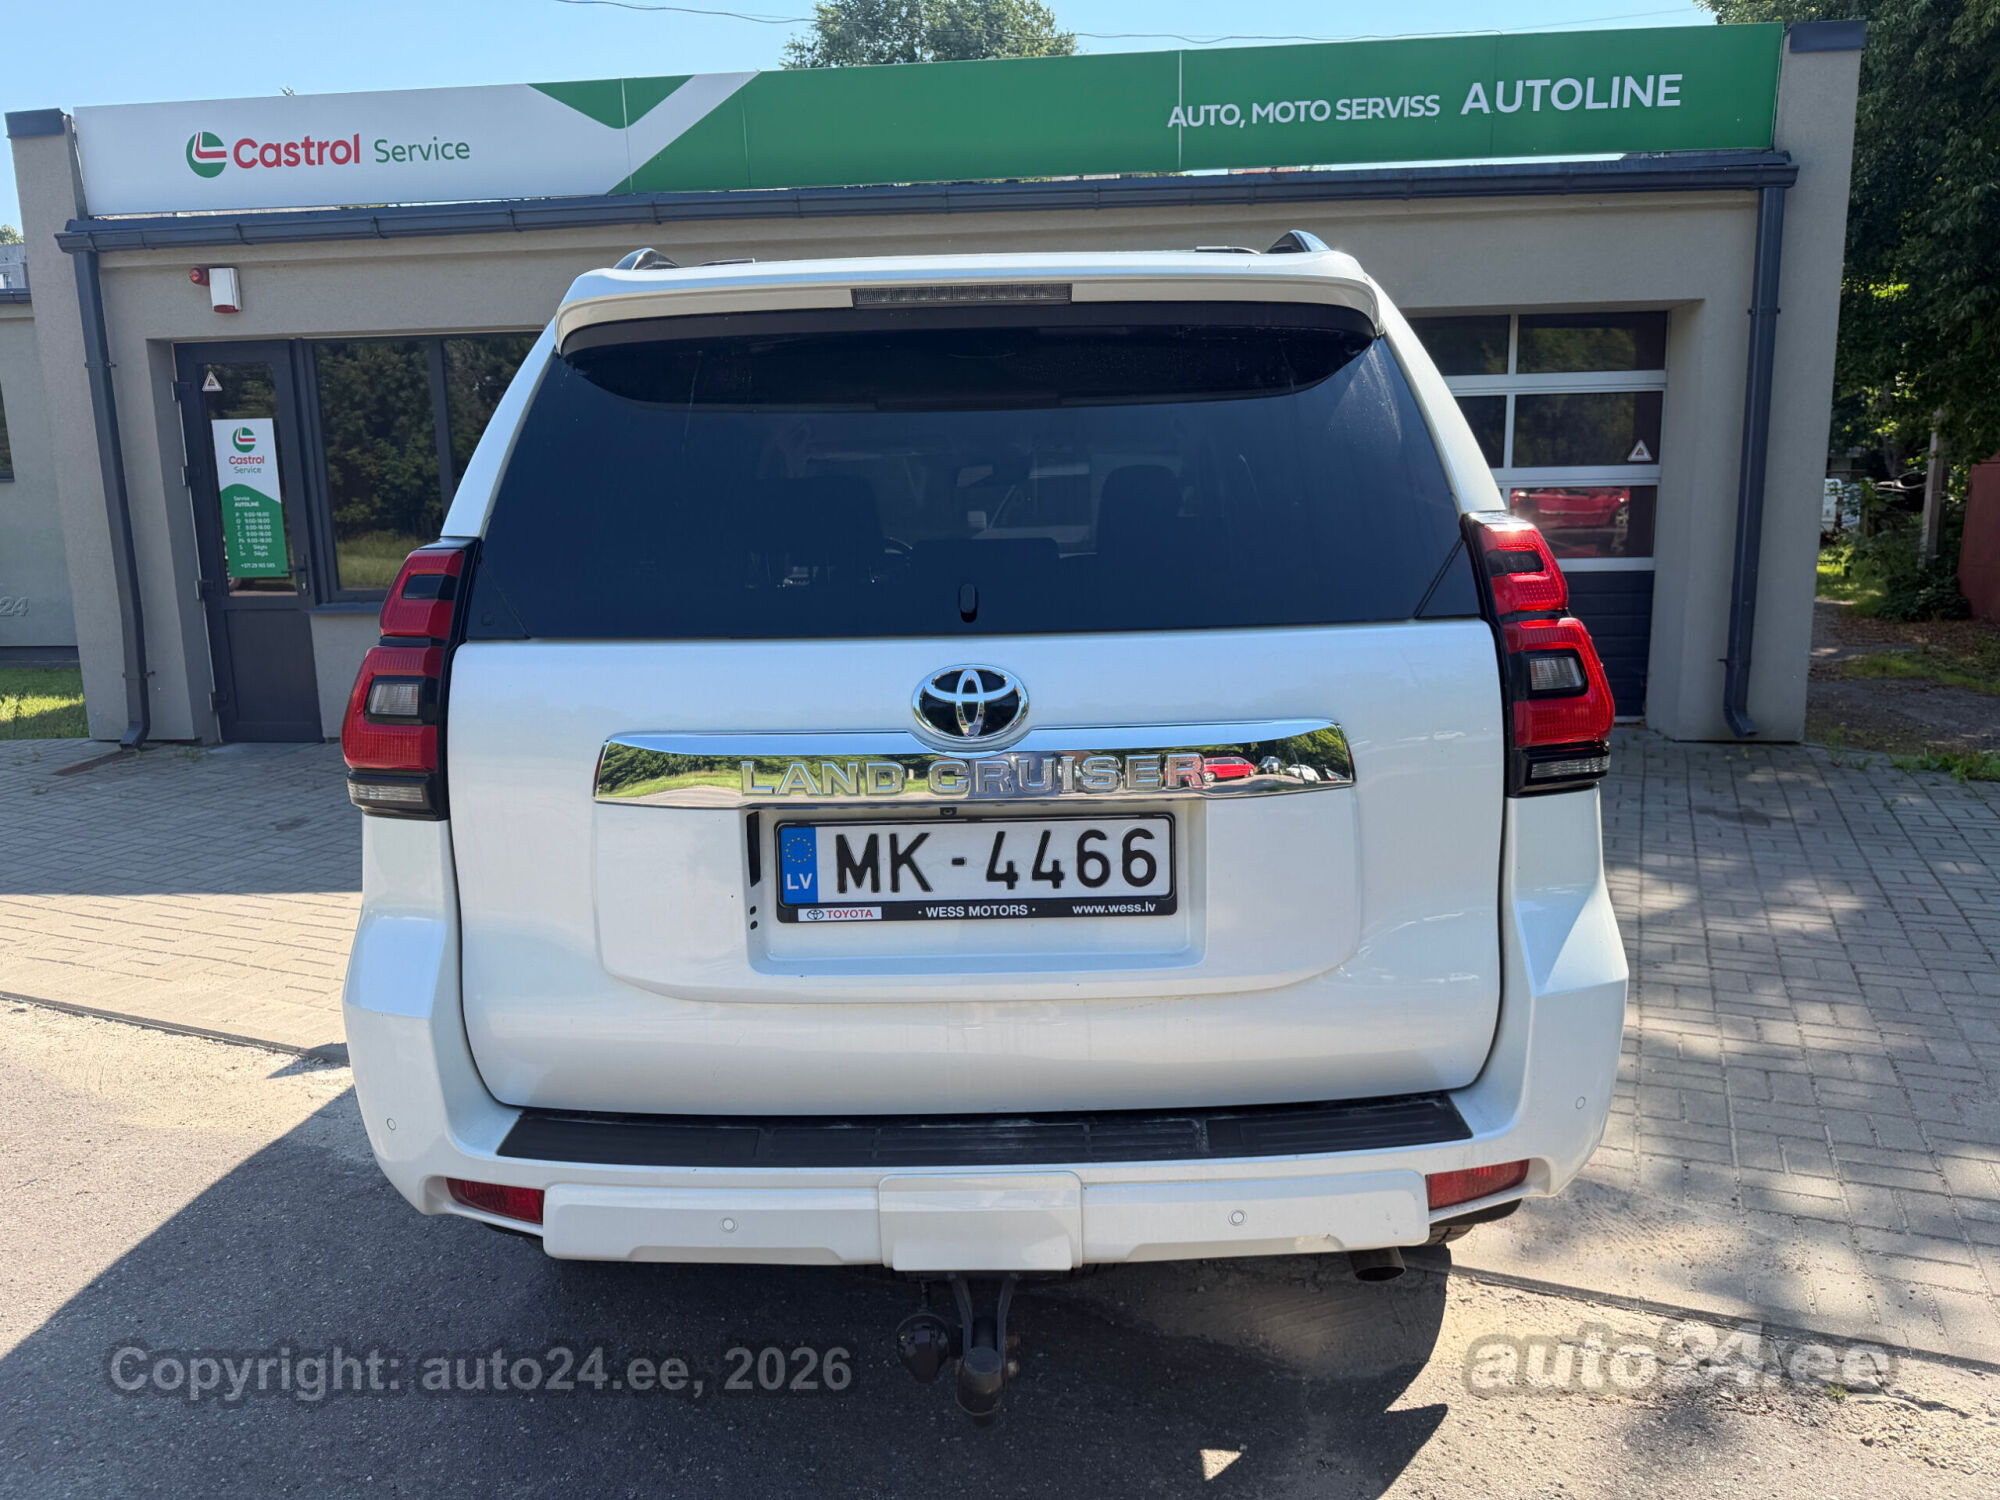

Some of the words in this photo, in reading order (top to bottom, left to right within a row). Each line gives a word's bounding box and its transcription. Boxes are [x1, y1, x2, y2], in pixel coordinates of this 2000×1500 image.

[1167, 104, 1246, 128] AUTO,
[1251, 99, 1331, 125] MOTO
[1335, 94, 1440, 121] SERVISS
[1460, 73, 1683, 115] AUTOLINE
[233, 133, 361, 169] Castrol
[374, 136, 471, 163] Service
[229, 455, 265, 465] Castrol
[233, 466, 262, 474] Service
[740, 760, 905, 796] LAND
[928, 753, 1205, 796] CRUISER
[786, 873, 813, 890] LV
[826, 908, 874, 919] TOYOTA
[926, 906, 965, 918] WESS
[968, 904, 1028, 917] MOTORS
[1072, 901, 1157, 914] www.wess.lv
